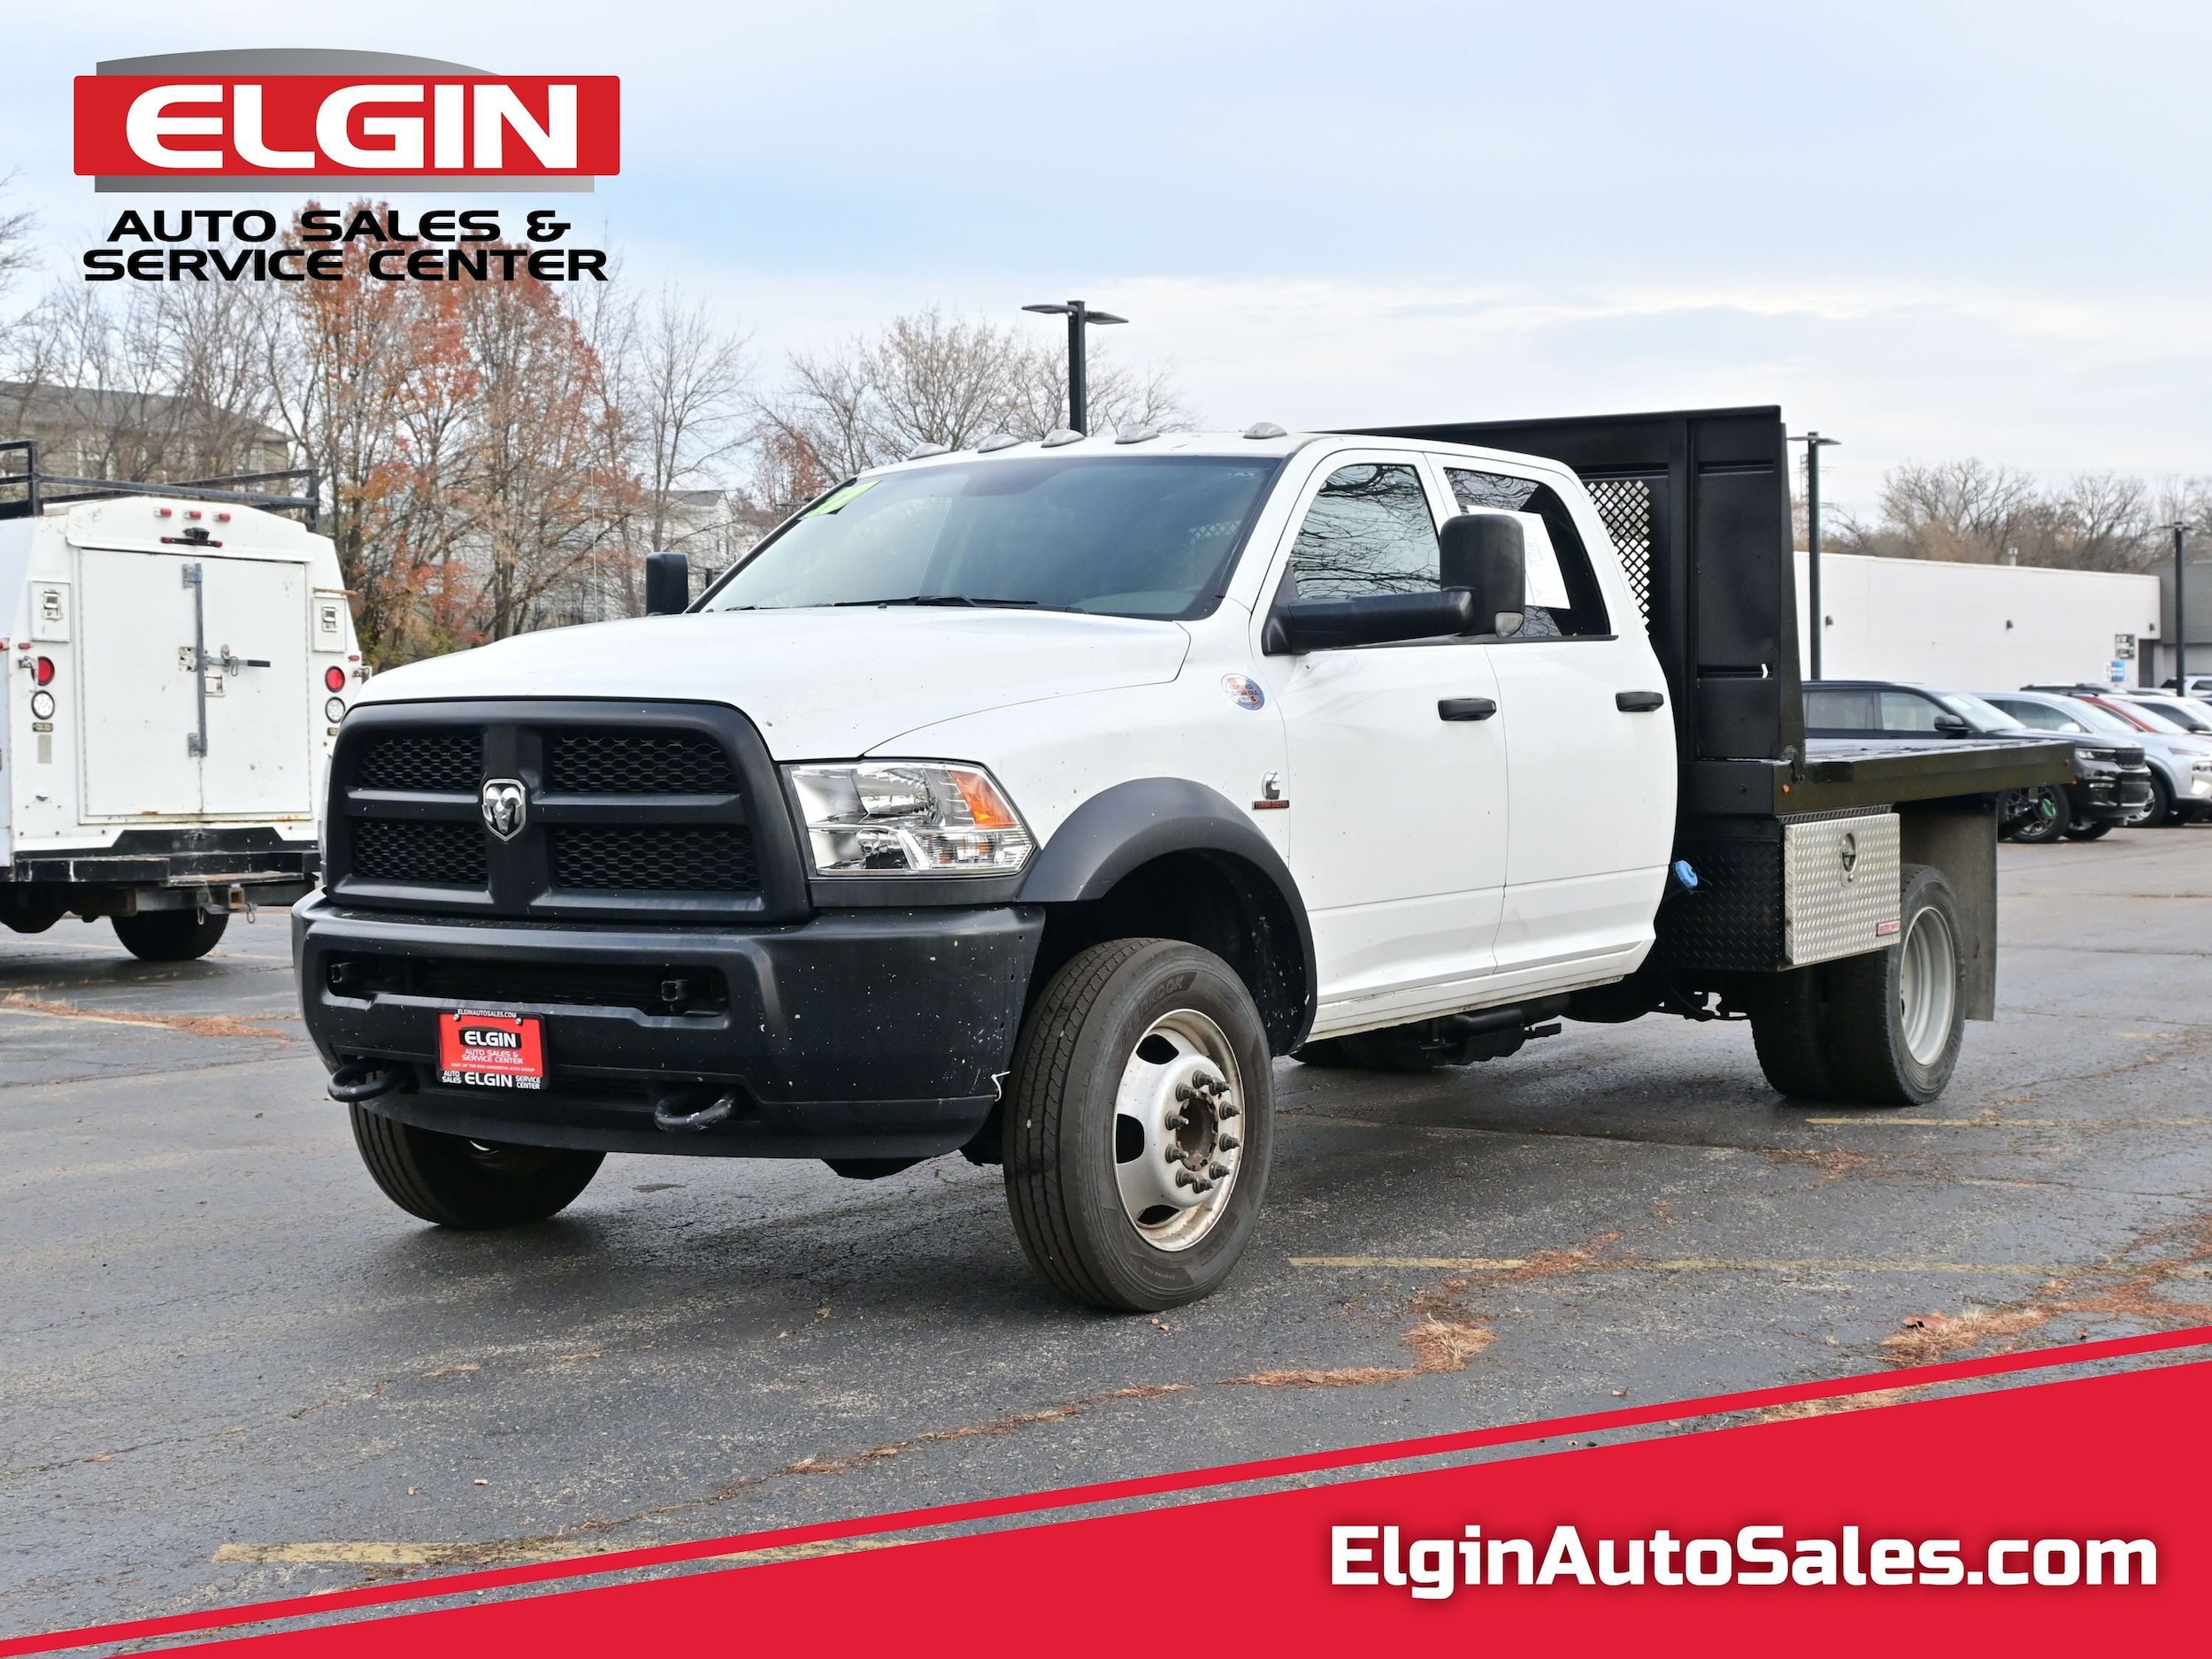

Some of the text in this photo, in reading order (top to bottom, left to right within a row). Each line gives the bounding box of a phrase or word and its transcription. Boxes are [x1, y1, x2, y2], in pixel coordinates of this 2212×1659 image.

[457, 1009, 518, 1018] ELGINAUTOSALES.COM
[465, 1031, 517, 1048] ELGIN
[461, 1054, 524, 1064] SERVICE CENTER
[464, 1071, 513, 1087] ELGIN
[515, 1075, 541, 1084] SERVICE
